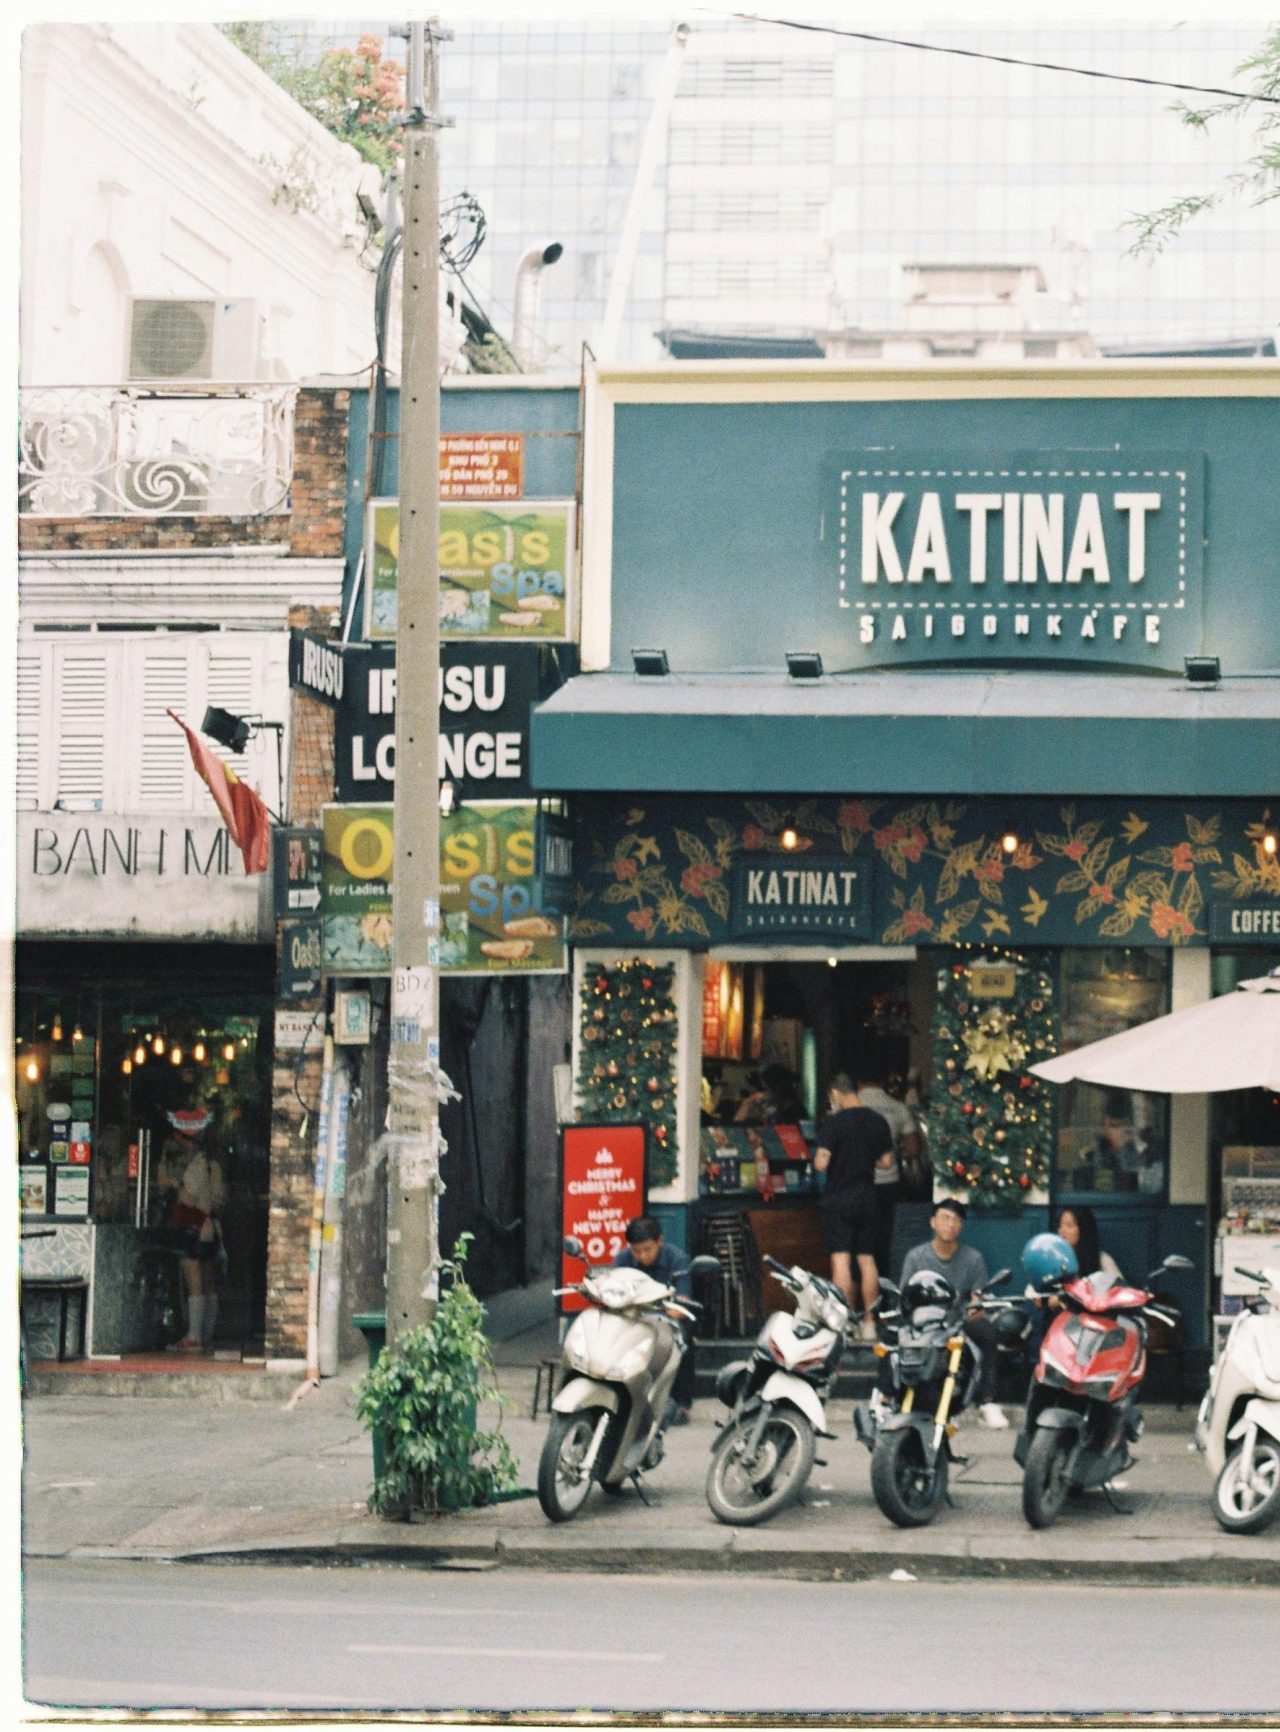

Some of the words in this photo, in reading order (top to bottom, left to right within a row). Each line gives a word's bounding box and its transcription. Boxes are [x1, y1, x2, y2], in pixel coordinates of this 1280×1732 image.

[390, 525, 551, 566] asis
[861, 492, 1161, 583] KATINAT
[491, 562, 564, 600] Spa
[303, 638, 343, 699] IRUSU
[368, 665, 505, 714] IRSU
[352, 732, 521, 780] LONGE
[340, 818, 534, 879] Osis
[329, 884, 345, 895] For
[350, 883, 384, 896] Ladies
[748, 869, 857, 906] KATINAT
[568, 1178, 636, 1195] CHRISTMAS
[586, 1168, 622, 1180] MERRY
[573, 1221, 602, 1235] NEW
[604, 1219, 631, 1233] YEA
[588, 1208, 623, 1220] HAPPY
